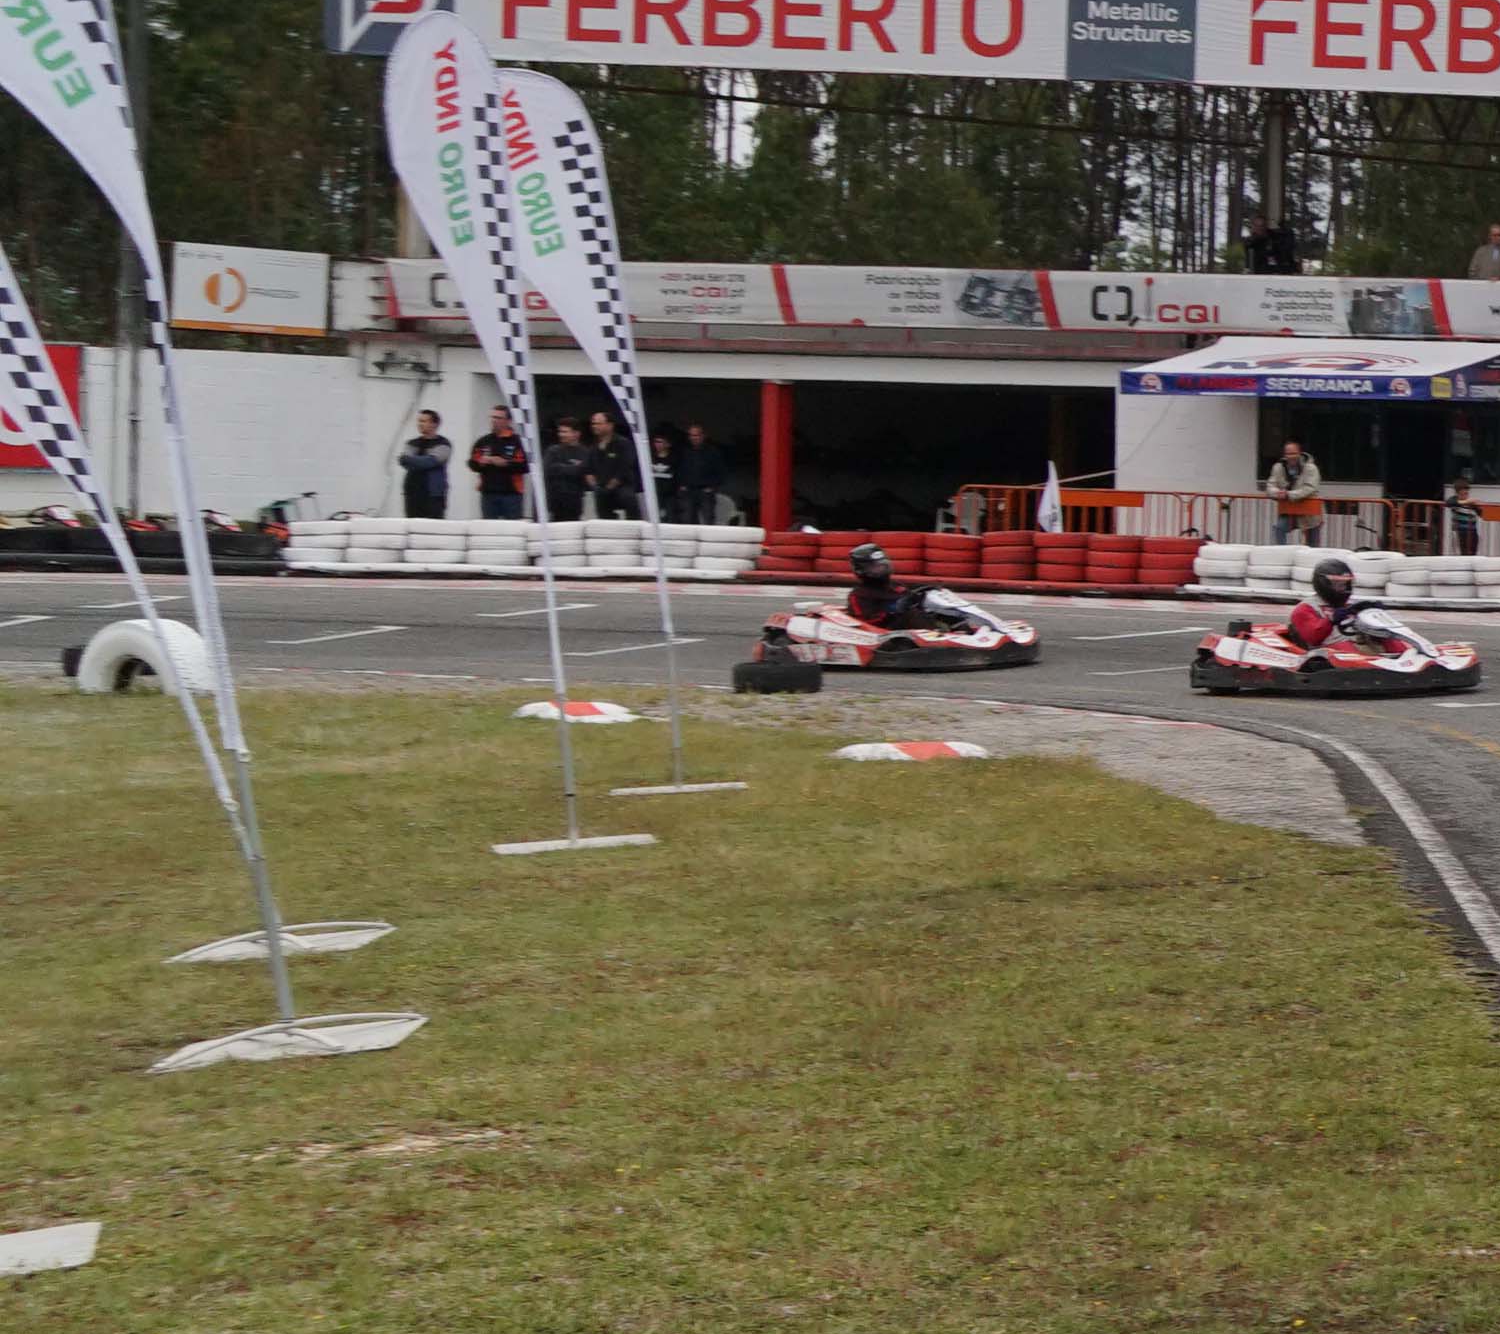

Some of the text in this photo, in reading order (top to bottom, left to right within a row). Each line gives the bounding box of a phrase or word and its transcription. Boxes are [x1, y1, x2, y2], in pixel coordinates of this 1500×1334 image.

[1087, 0, 1179, 23] Metallic
[1072, 21, 1192, 45] Structures
[1264, 376, 1374, 396] SEGURANÇA
